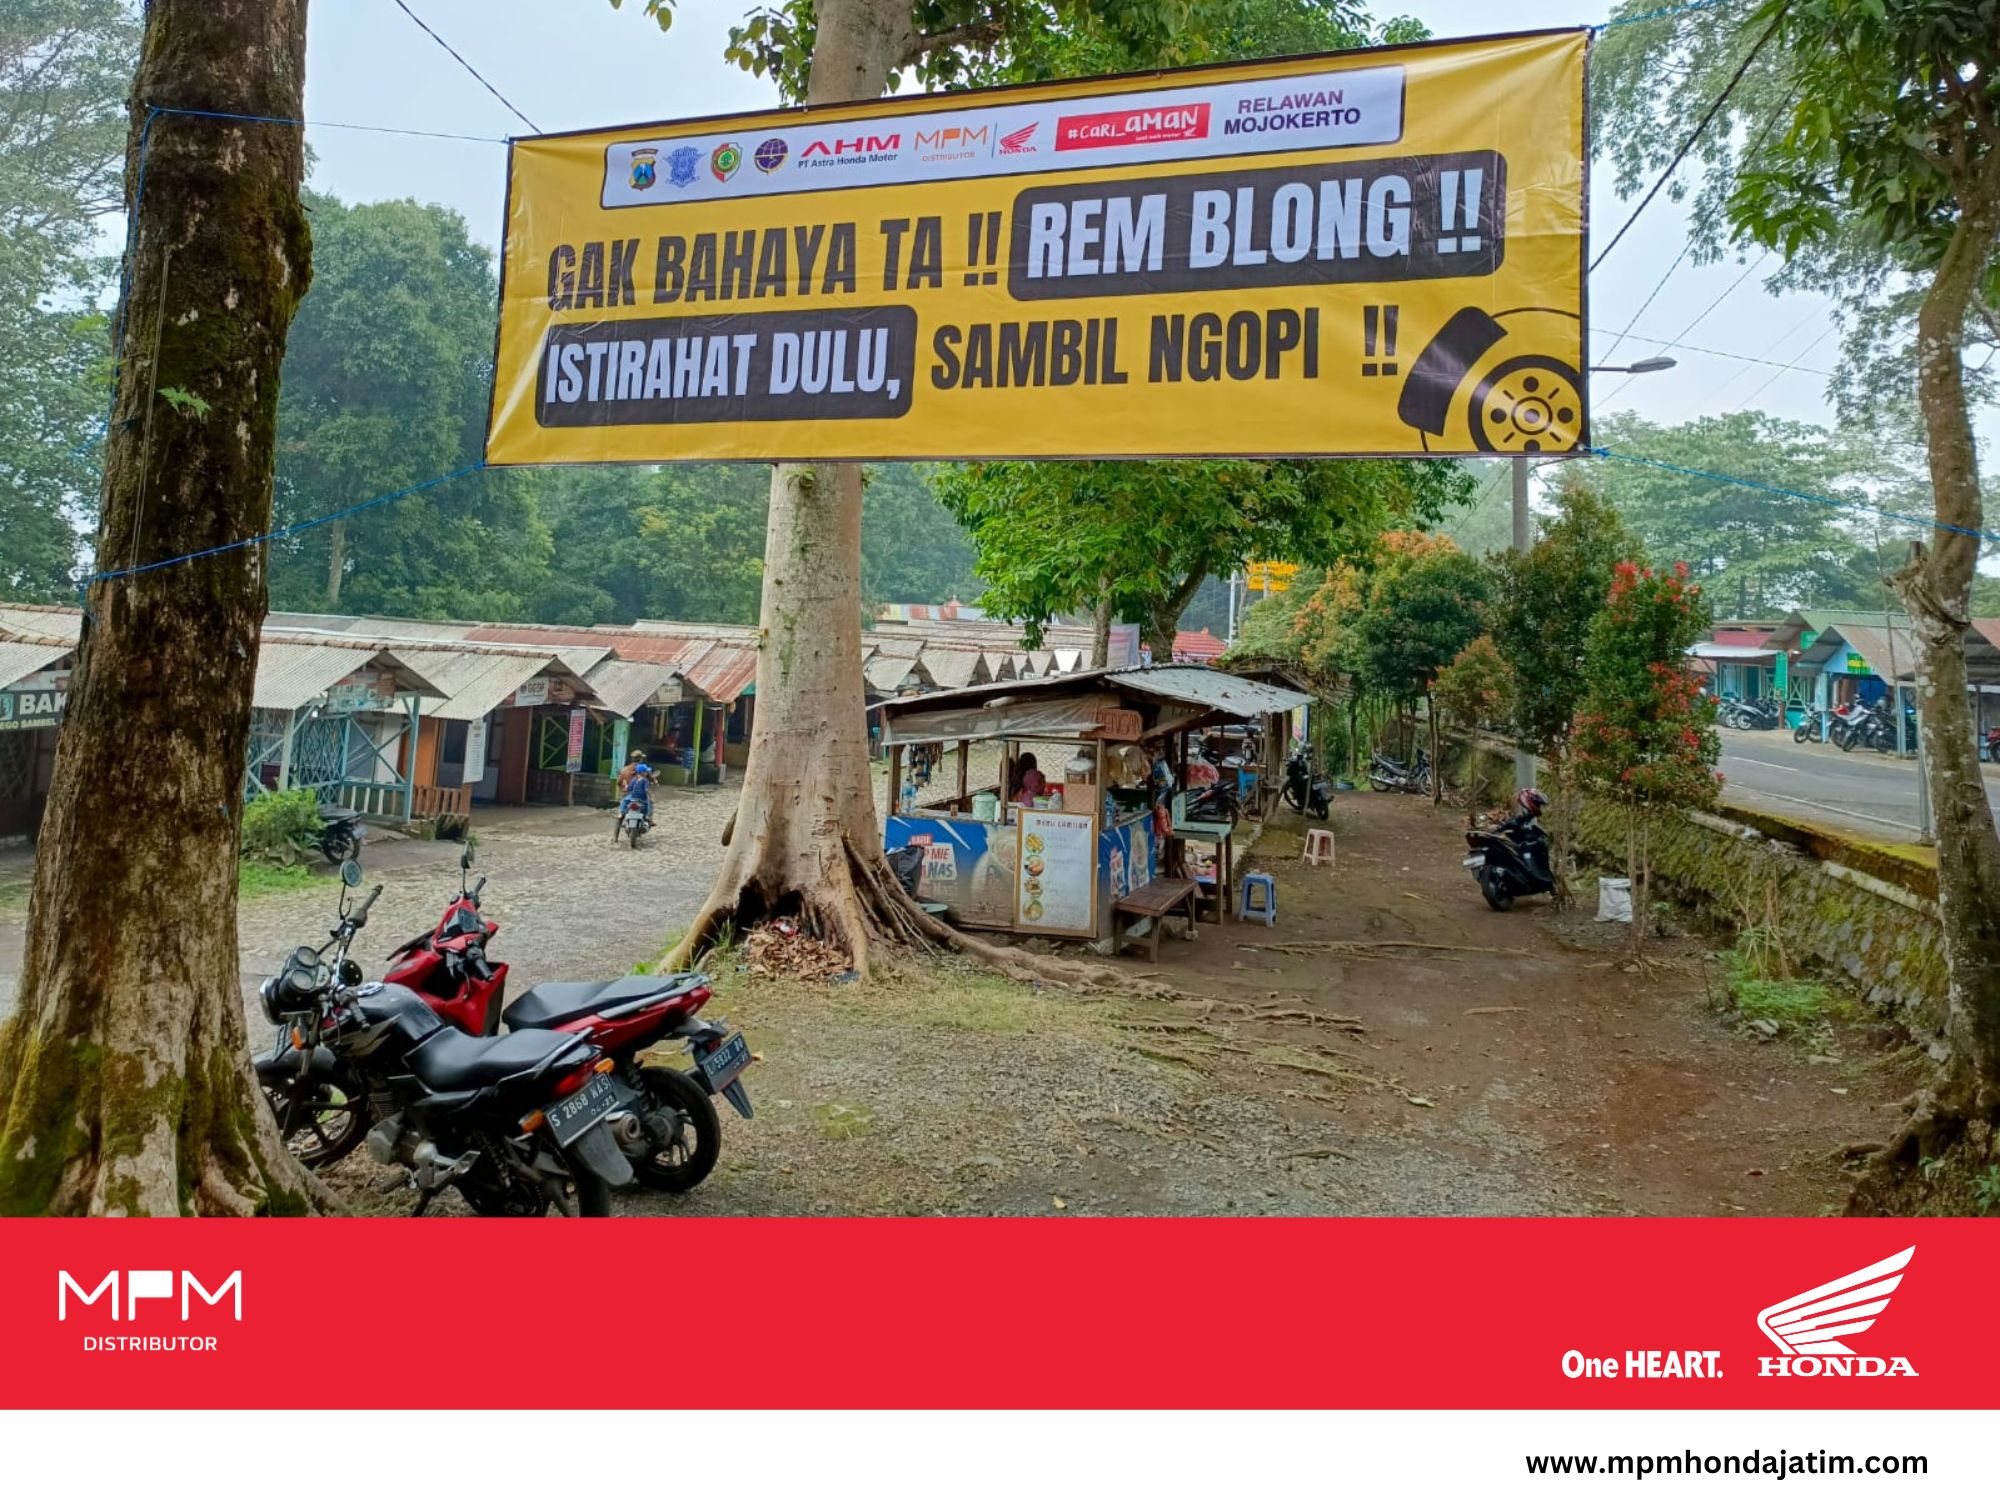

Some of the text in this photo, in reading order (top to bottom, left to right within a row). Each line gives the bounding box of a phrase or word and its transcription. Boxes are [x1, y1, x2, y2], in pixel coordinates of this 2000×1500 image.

[1237, 90, 1343, 114] RELAWAN
[1224, 108, 1361, 135] MOJOKERTO
[801, 134, 900, 157] AHM
[914, 125, 988, 151] MPM
[798, 153, 898, 168] PT Astra Honda Motor
[922, 151, 976, 162] DISTRIBUTOR
[999, 146, 1037, 156] HONDA
[548, 169, 1484, 312] GAK BAHAYA TA !! REM BLONG !!
[546, 305, 1399, 404] ISTIRAHAT DULU, SAMBIL NGOPI !!
[551, 1114, 561, 1127] S
[563, 1094, 589, 1119] 2868
